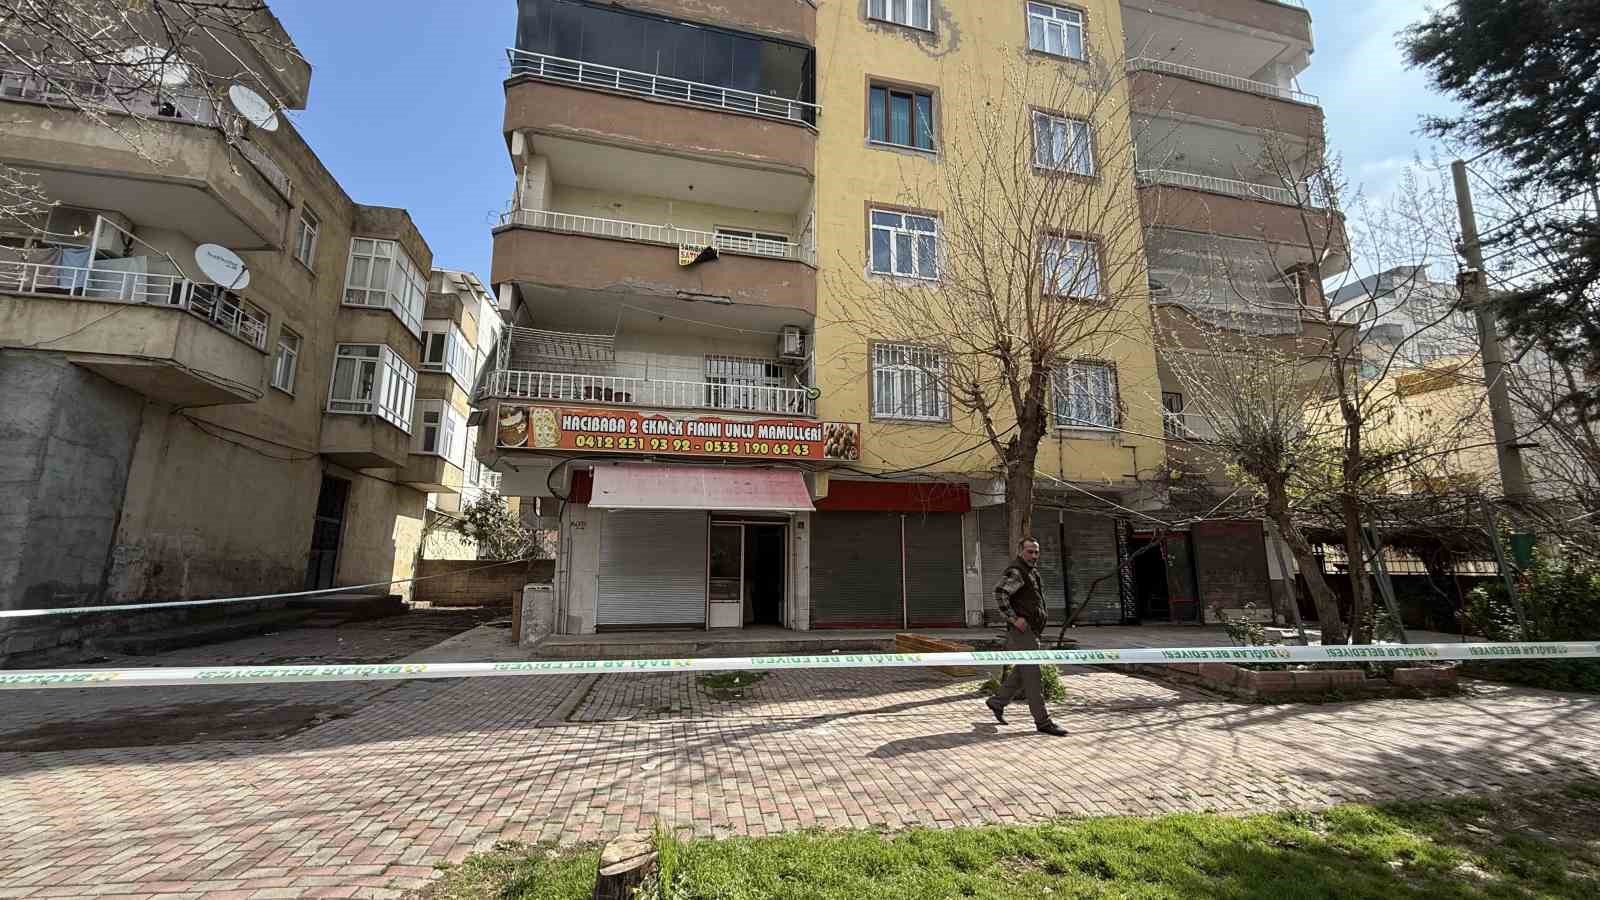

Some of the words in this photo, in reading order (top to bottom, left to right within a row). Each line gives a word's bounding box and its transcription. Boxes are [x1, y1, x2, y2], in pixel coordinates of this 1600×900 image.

[562, 415, 625, 433] HACIBABA
[629, 419, 638, 433] 2
[641, 419, 684, 436] EKMEK
[687, 422, 721, 438] FIRINI
[758, 423, 822, 441] MAMÜLLERİ
[576, 435, 614, 448] 0412
[618, 436, 645, 449] 251
[650, 438, 668, 450] 93
[672, 439, 691, 451] 92
[704, 440, 738, 453] 0533
[744, 442, 768, 454] 190
[772, 444, 789, 455] 62
[793, 444, 809, 456] 43
